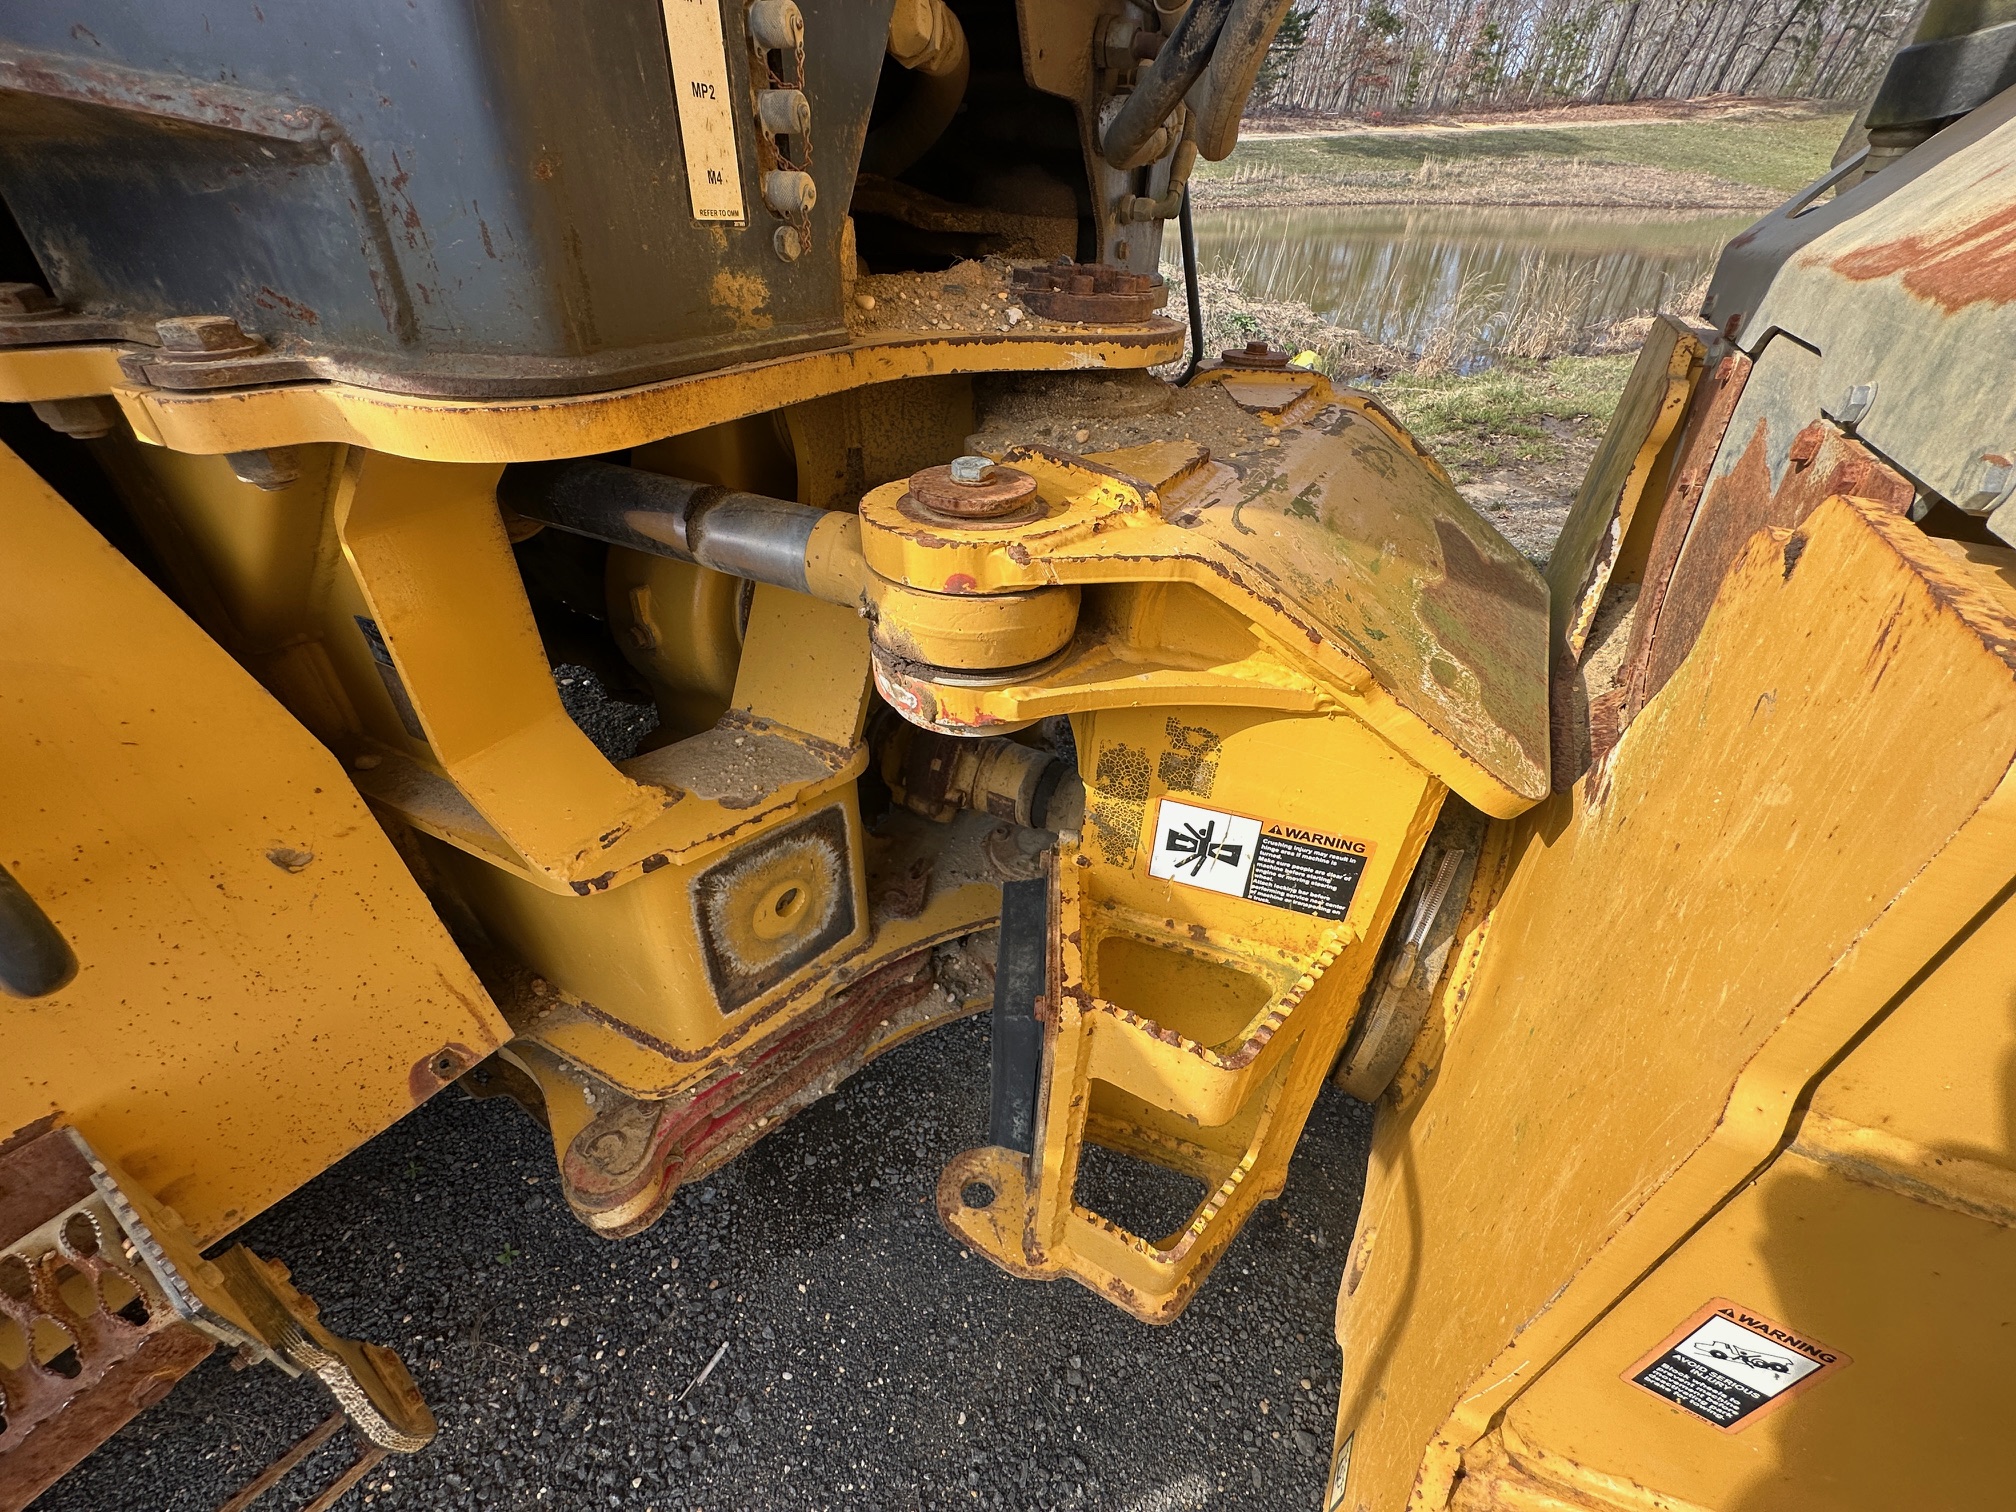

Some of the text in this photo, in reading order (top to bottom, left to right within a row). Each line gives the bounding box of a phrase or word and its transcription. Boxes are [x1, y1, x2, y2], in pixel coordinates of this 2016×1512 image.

[691, 81, 716, 100] MP2
[707, 170, 723, 185] M4
[699, 209, 718, 217] REFER
[718, 209, 727, 217] TO
[1263, 839, 1292, 850] Crushing
[1294, 845, 1313, 854] injury
[1329, 854, 1348, 862] result
[1285, 826, 1366, 853] WARNING
[1260, 850, 1282, 859] turned.
[1261, 844, 1279, 853] hinge
[1302, 854, 1330, 864] machine
[1256, 868, 1276, 876] engine
[1286, 874, 1310, 885] moving
[1310, 881, 1337, 891] steering
[1257, 863, 1332, 884] machine before starting
[1291, 865, 1314, 873] people
[1252, 879, 1273, 887] Attach
[1274, 883, 1297, 893] locking
[1310, 892, 1330, 901] before
[1257, 892, 1283, 901] machine
[1286, 893, 1309, 901] service
[1738, 1313, 1837, 1364] WARNING
[1661, 1363, 1690, 1379] Block
[1692, 1379, 1727, 1398] wheels
[1672, 1355, 1760, 1398] AVOID SERIOUS
[1690, 1369, 1732, 1390] INJURY
[1644, 1376, 1671, 1392] brake
[1673, 1391, 1688, 1399] for
[1689, 1400, 1724, 1420] towing.
[1647, 1374, 1710, 1405] deactivating
[1709, 1405, 1733, 1418] park
[1653, 1370, 1739, 1415] movement before
[1656, 1367, 1739, 1410] prevent machine
